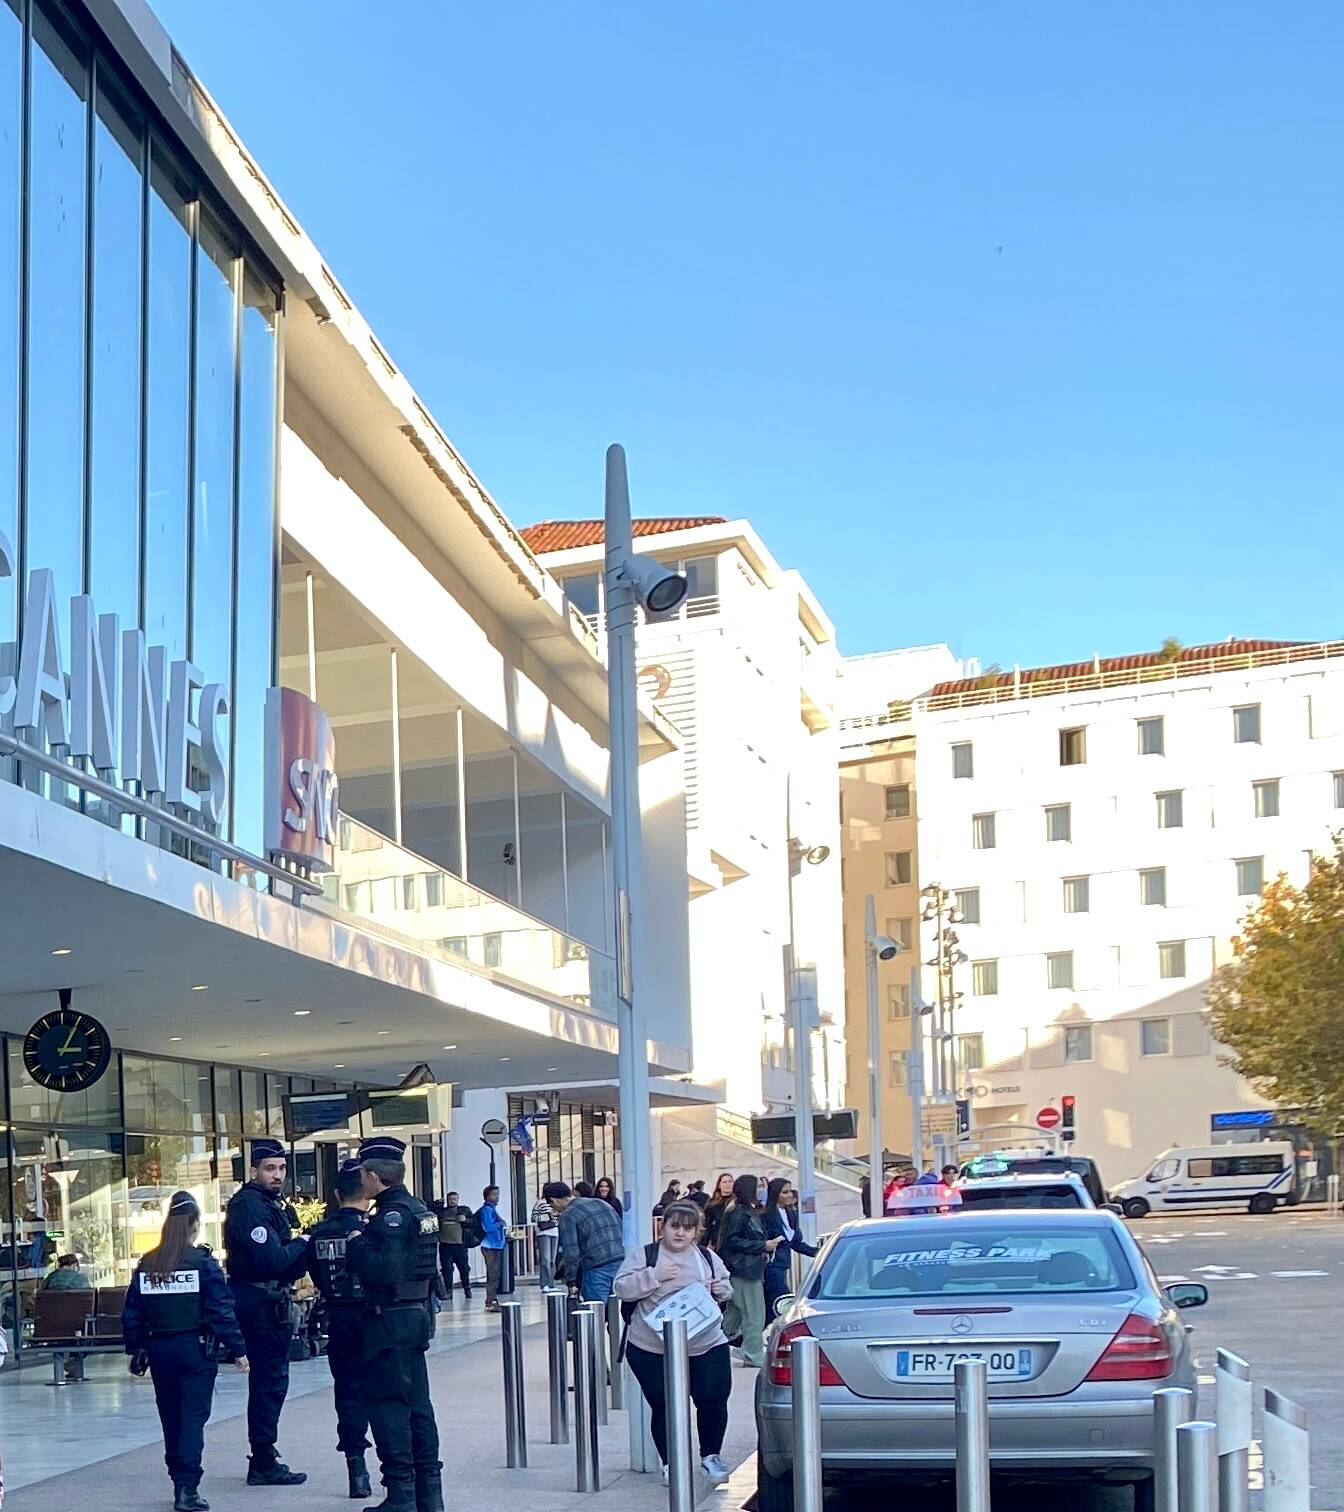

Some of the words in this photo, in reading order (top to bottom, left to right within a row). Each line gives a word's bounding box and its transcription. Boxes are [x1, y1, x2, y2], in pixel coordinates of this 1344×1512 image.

[283, 757, 340, 846] SNC
[884, 1247, 983, 1264] FITNESS
[987, 1246, 1055, 1259] PARK
[912, 1353, 1016, 1371] FR-7-QQ
